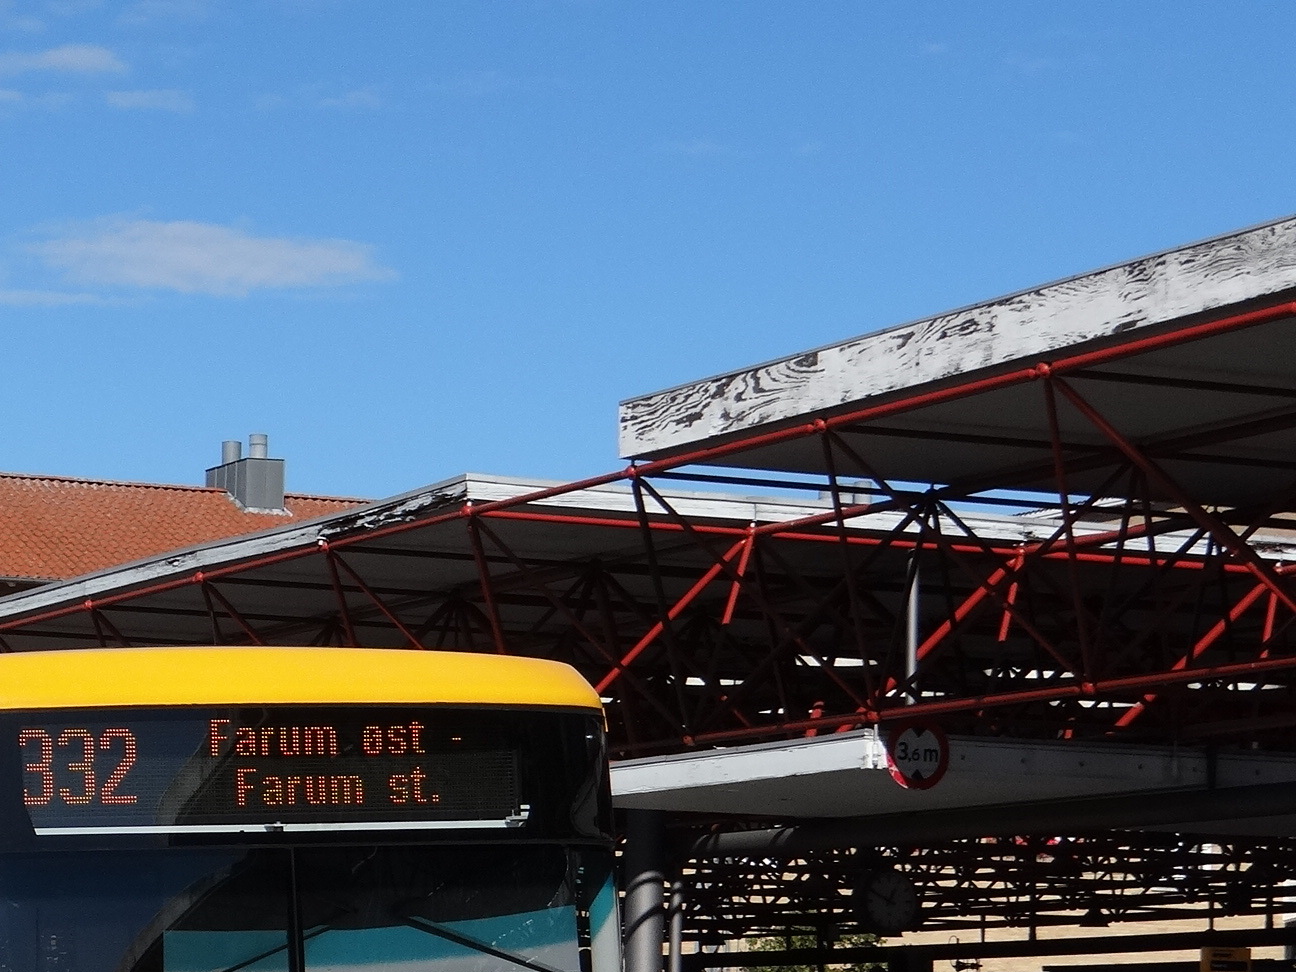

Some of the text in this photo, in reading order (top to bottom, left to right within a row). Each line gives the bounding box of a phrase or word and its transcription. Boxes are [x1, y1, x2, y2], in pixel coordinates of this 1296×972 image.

[211, 719, 337, 756] Farum
[18, 728, 137, 806] 332
[236, 767, 440, 806] Farum st.
